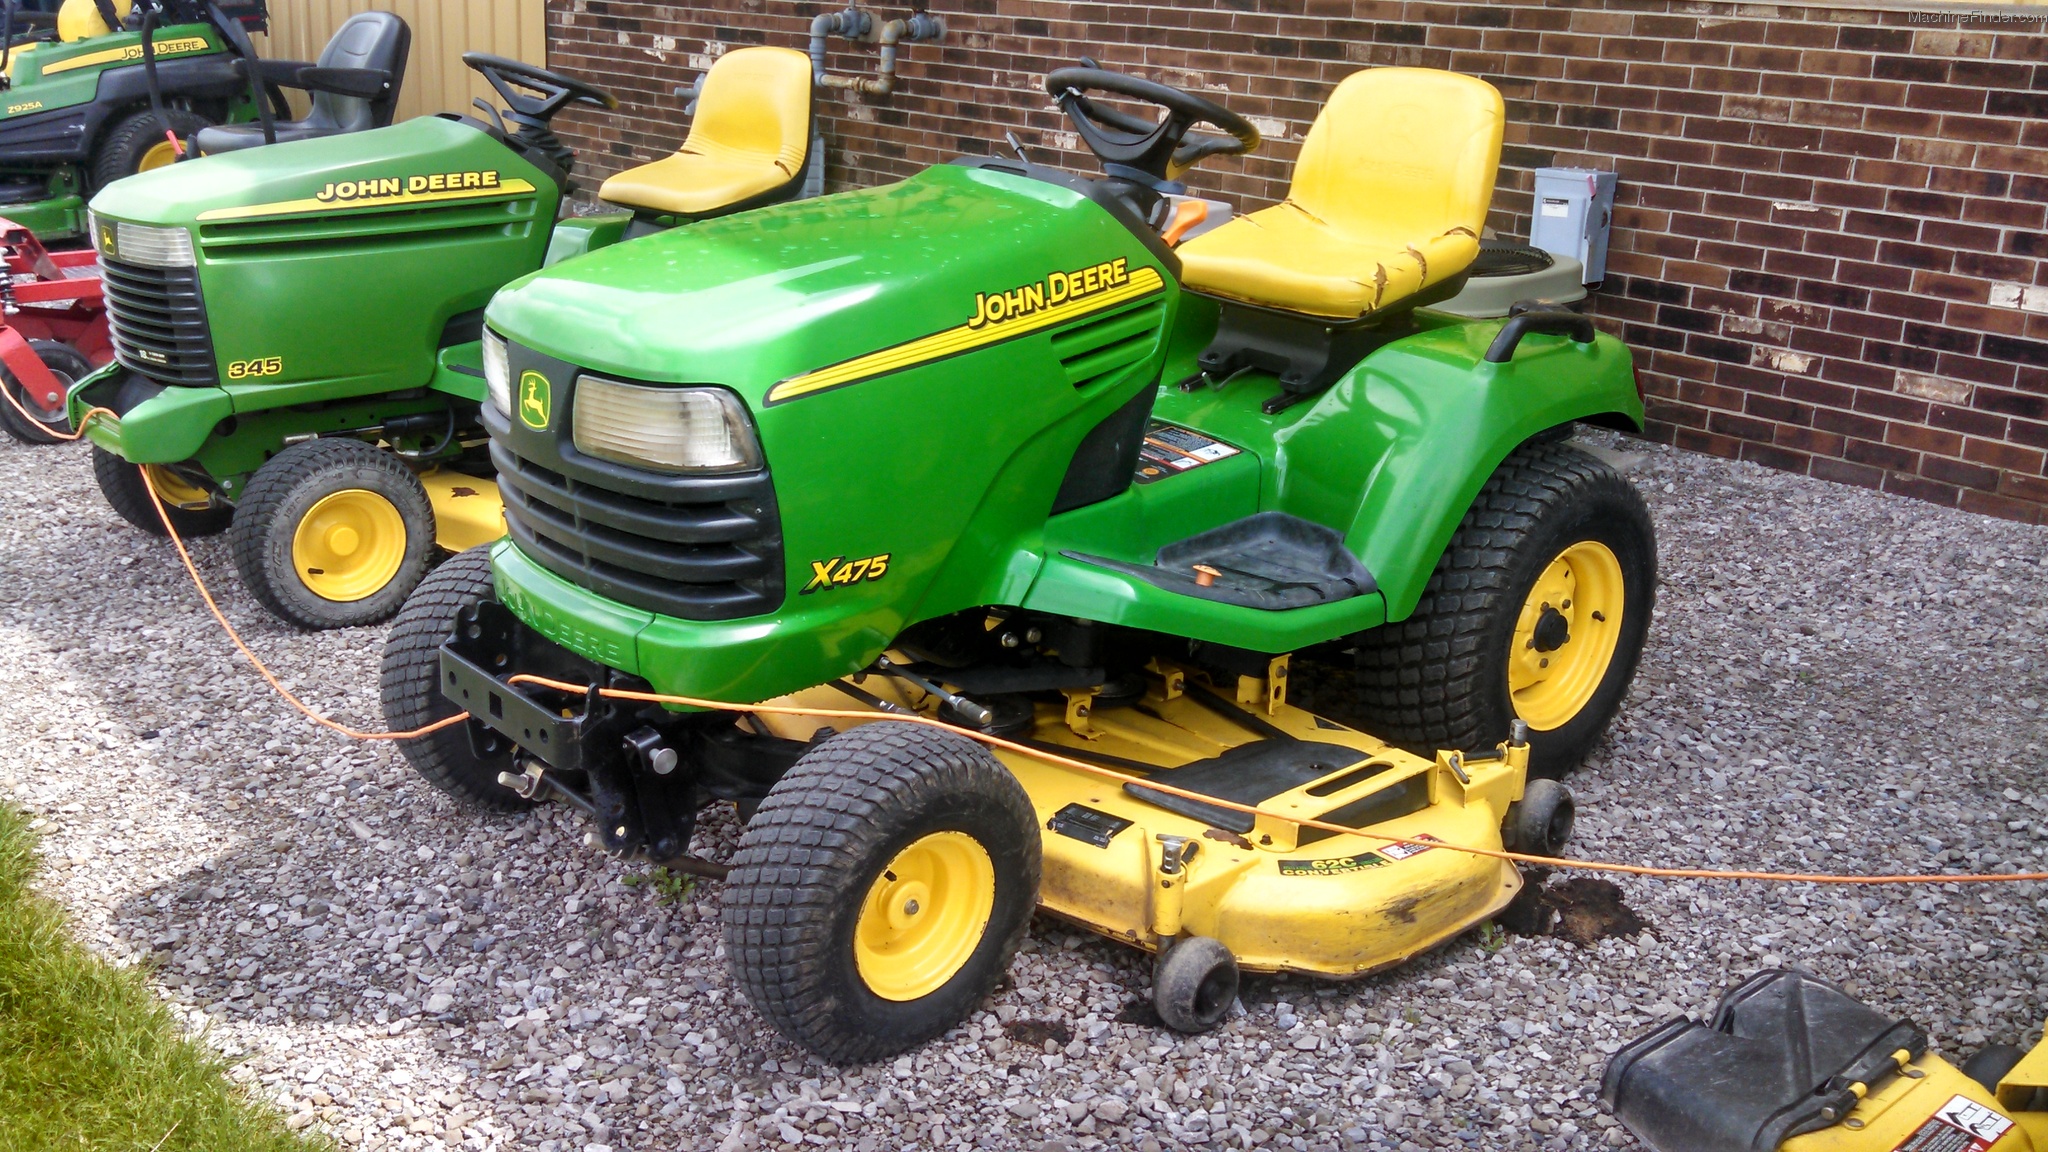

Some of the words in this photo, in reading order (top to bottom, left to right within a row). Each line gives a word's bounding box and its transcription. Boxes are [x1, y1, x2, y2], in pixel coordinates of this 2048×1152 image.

[157, 40, 200, 54] DEERE
[7, 101, 43, 114] Z925A
[316, 177, 403, 203] JOHN
[407, 170, 500, 194] DEERE
[968, 281, 1048, 329] JOHN
[1048, 256, 1129, 307] DEERE
[228, 357, 282, 379] 345
[799, 552, 892, 595] X475
[542, 610, 621, 665] DEERE
[1283, 861, 1391, 876] CONVERTIBLE
[1311, 857, 1357, 870] 62C
